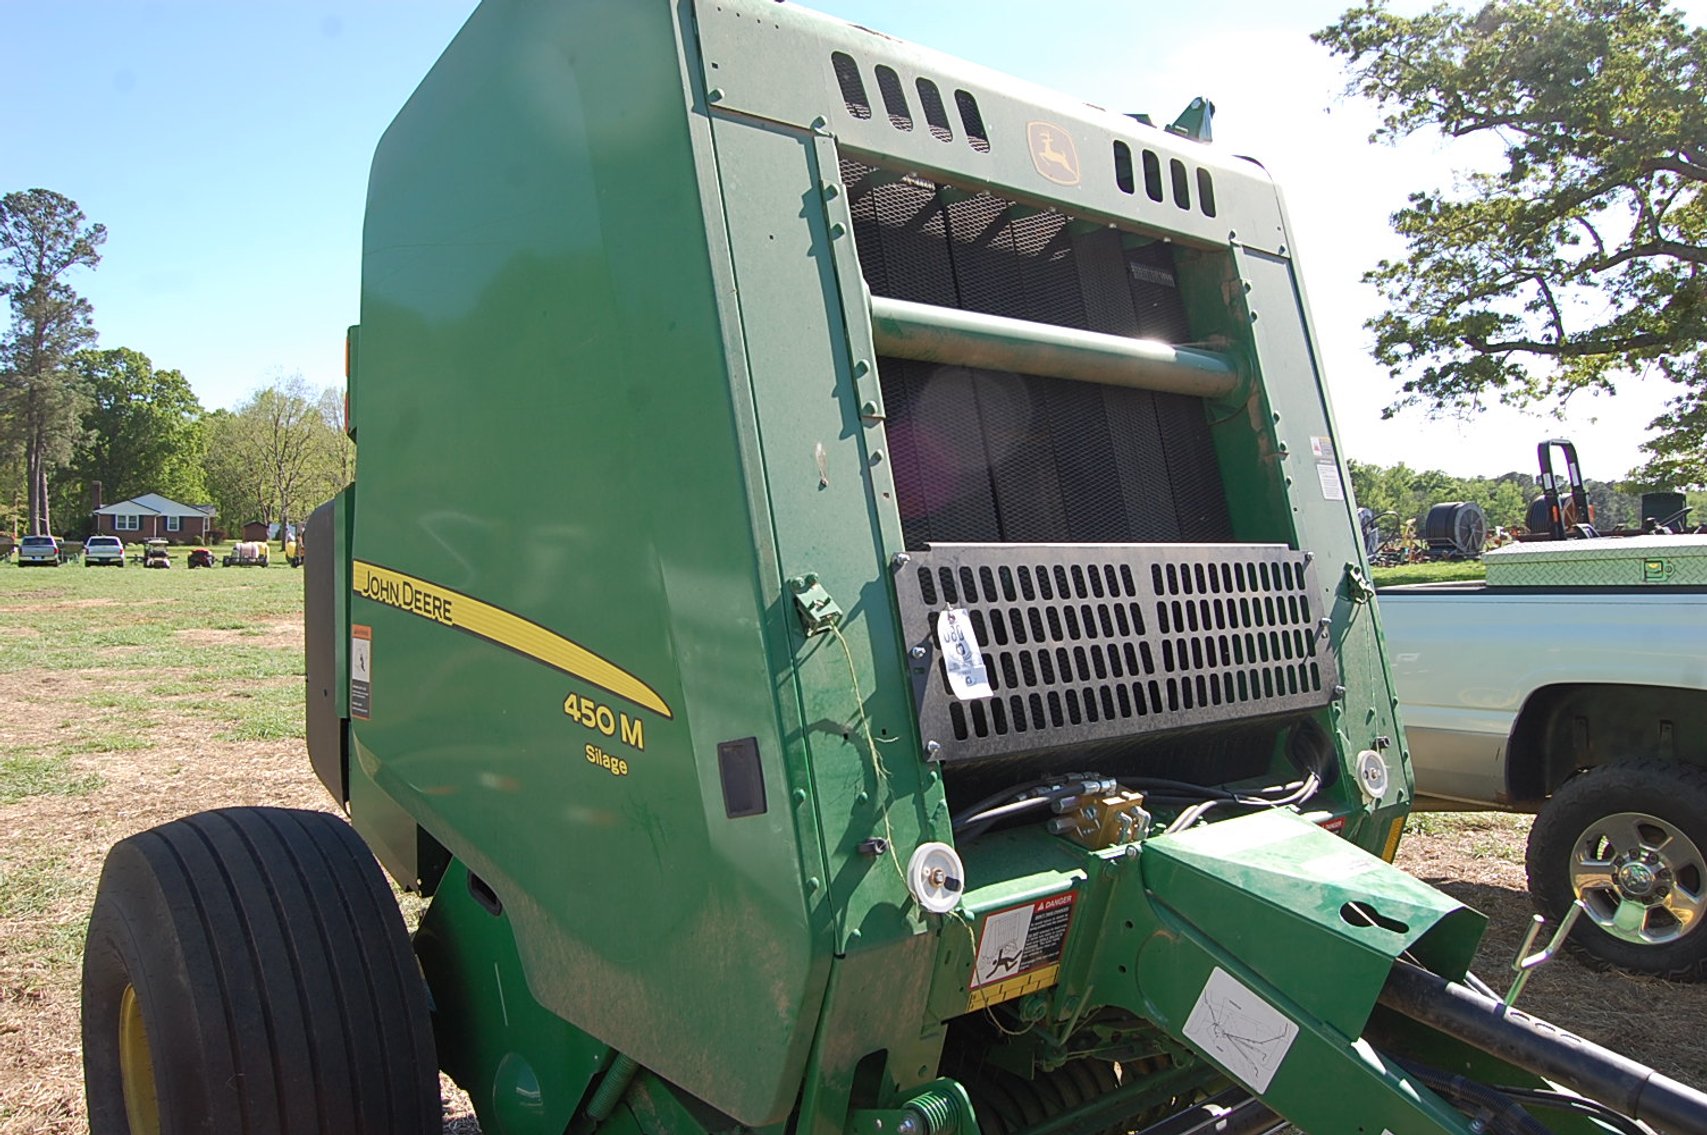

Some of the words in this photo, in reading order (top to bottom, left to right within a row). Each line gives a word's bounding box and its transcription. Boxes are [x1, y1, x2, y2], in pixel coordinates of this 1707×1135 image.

[363, 570, 399, 603] JOHN
[402, 581, 453, 621] DEERE
[563, 692, 617, 736] 450
[619, 712, 645, 750] M
[585, 744, 628, 775] Silage
[1045, 895, 1072, 908] DANGER
